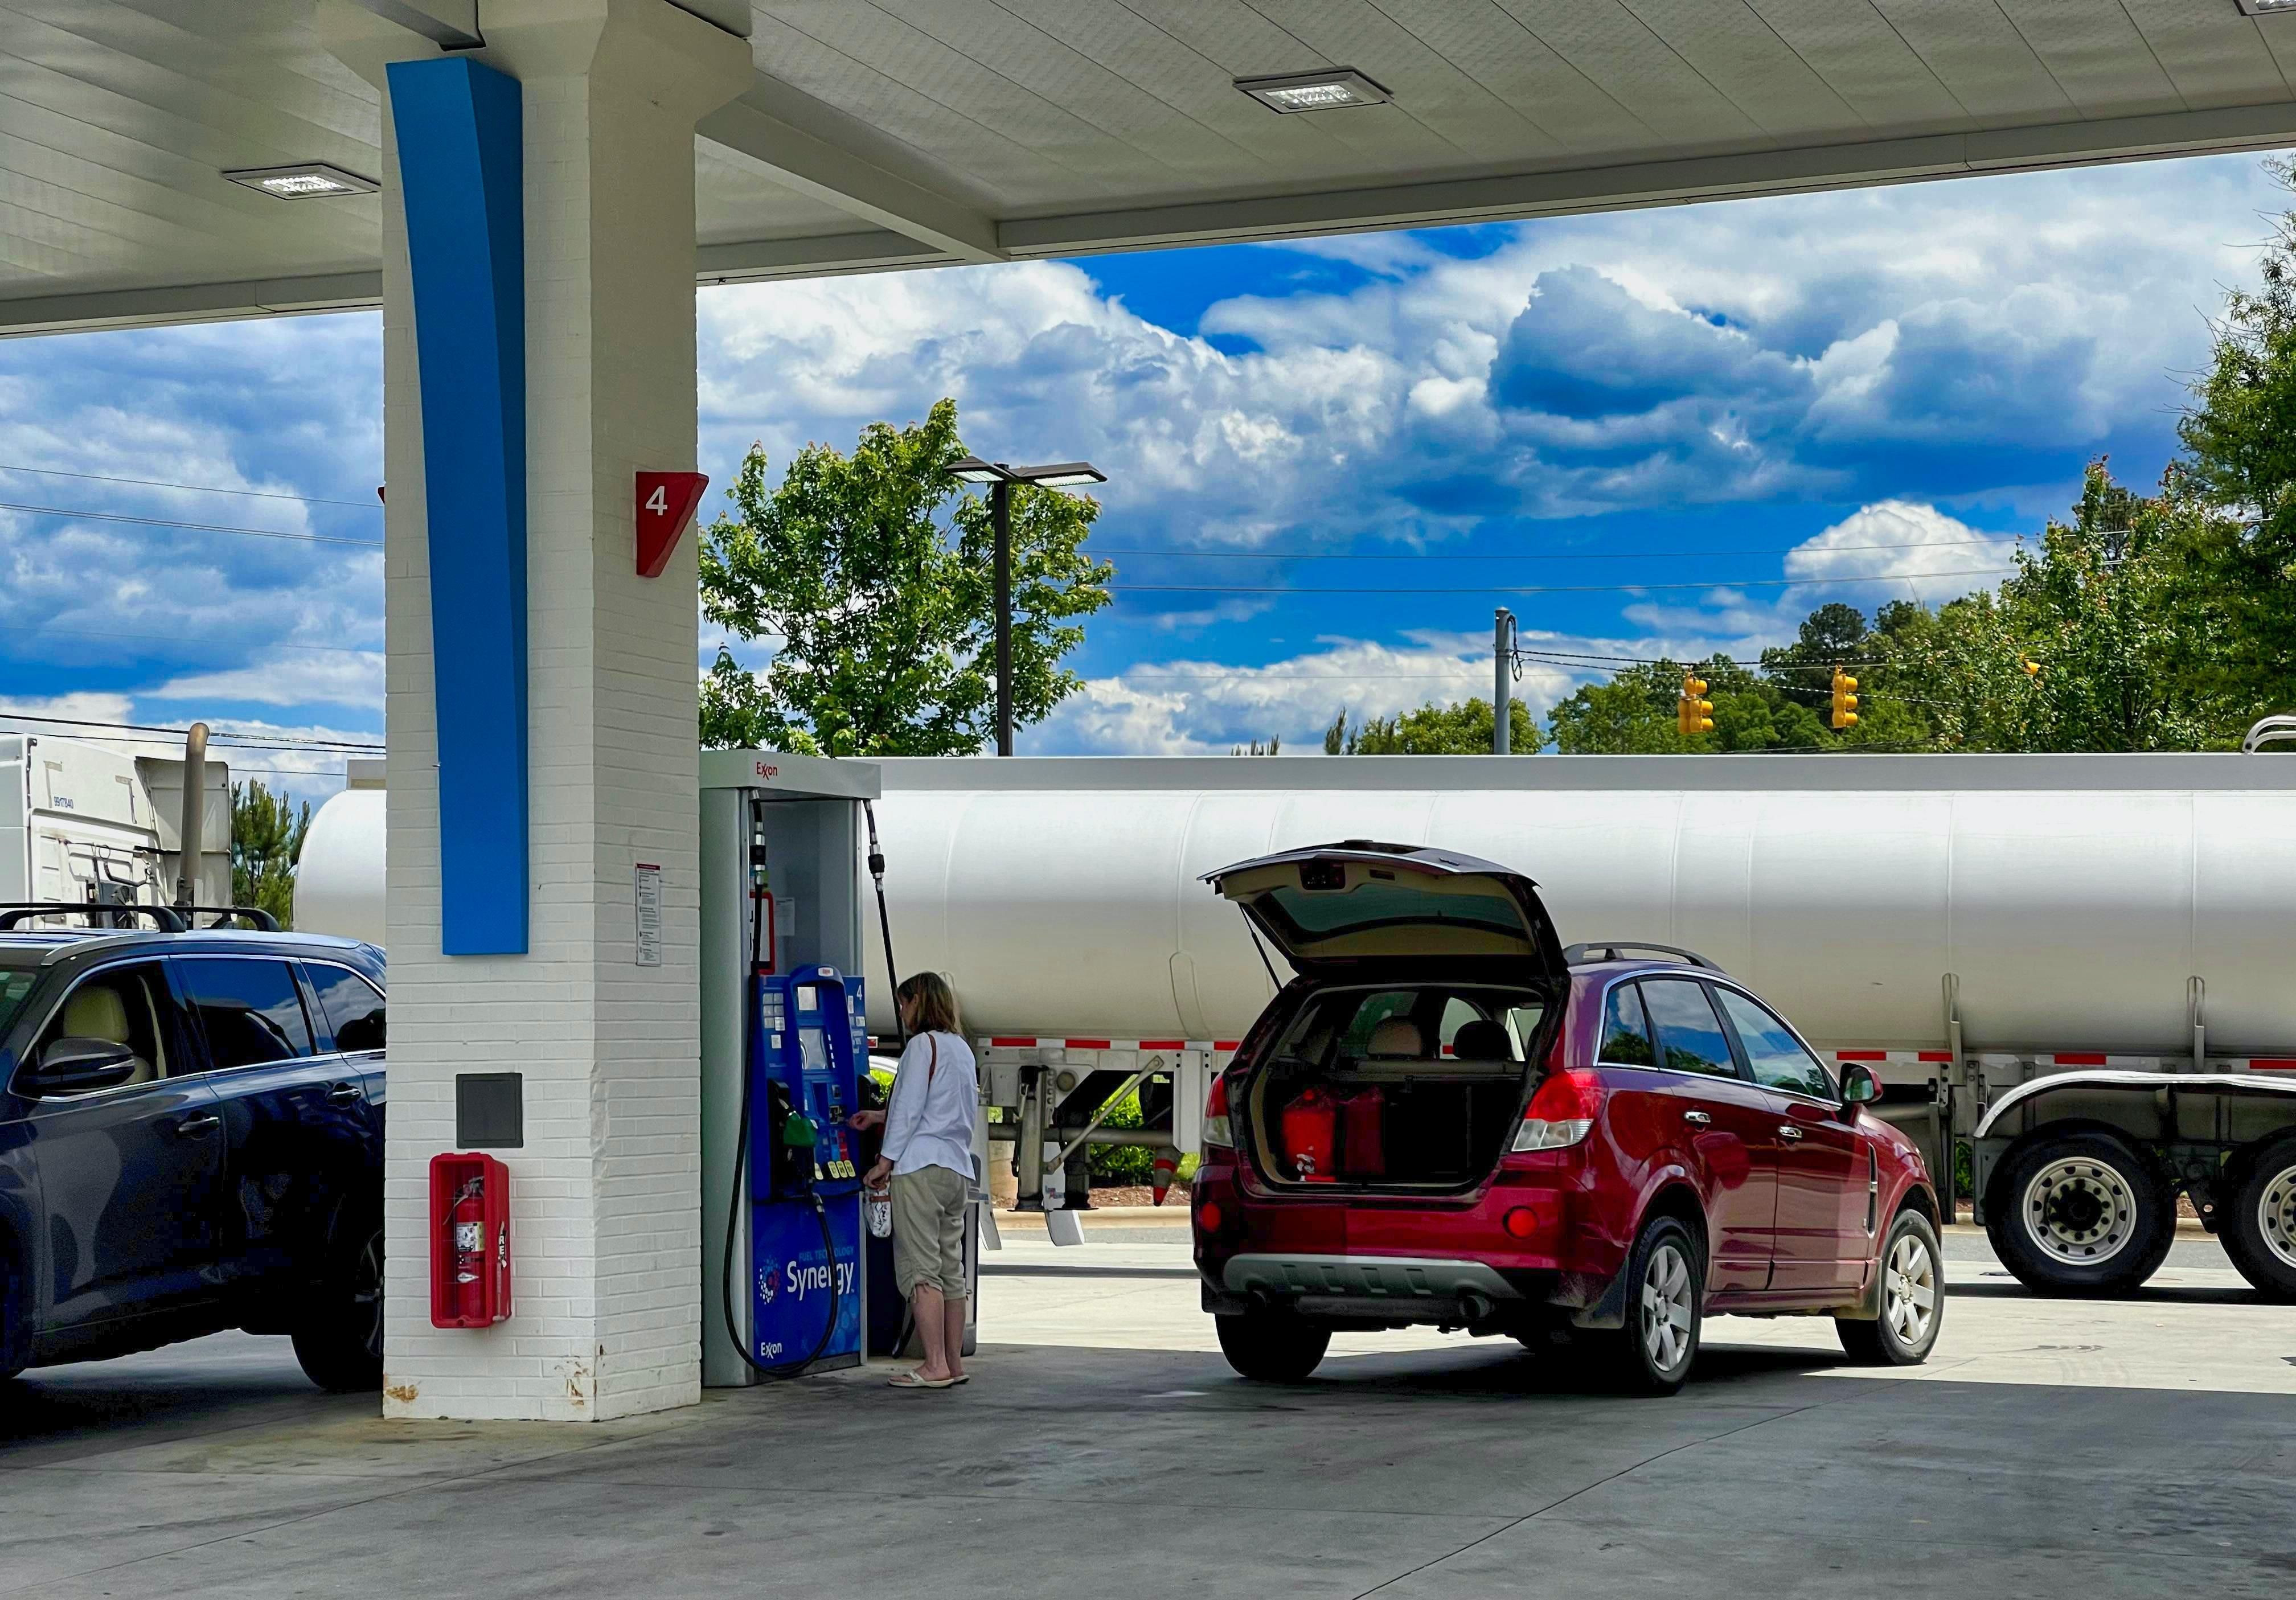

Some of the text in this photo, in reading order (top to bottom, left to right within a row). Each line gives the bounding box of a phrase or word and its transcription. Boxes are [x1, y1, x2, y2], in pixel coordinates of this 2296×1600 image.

[645, 485, 668, 516] 4
[756, 761, 778, 780] Exxon
[856, 984, 863, 1000] 4
[799, 1246, 854, 1262] FUEL TECOLOGY
[761, 1342, 782, 1359] Exxon
